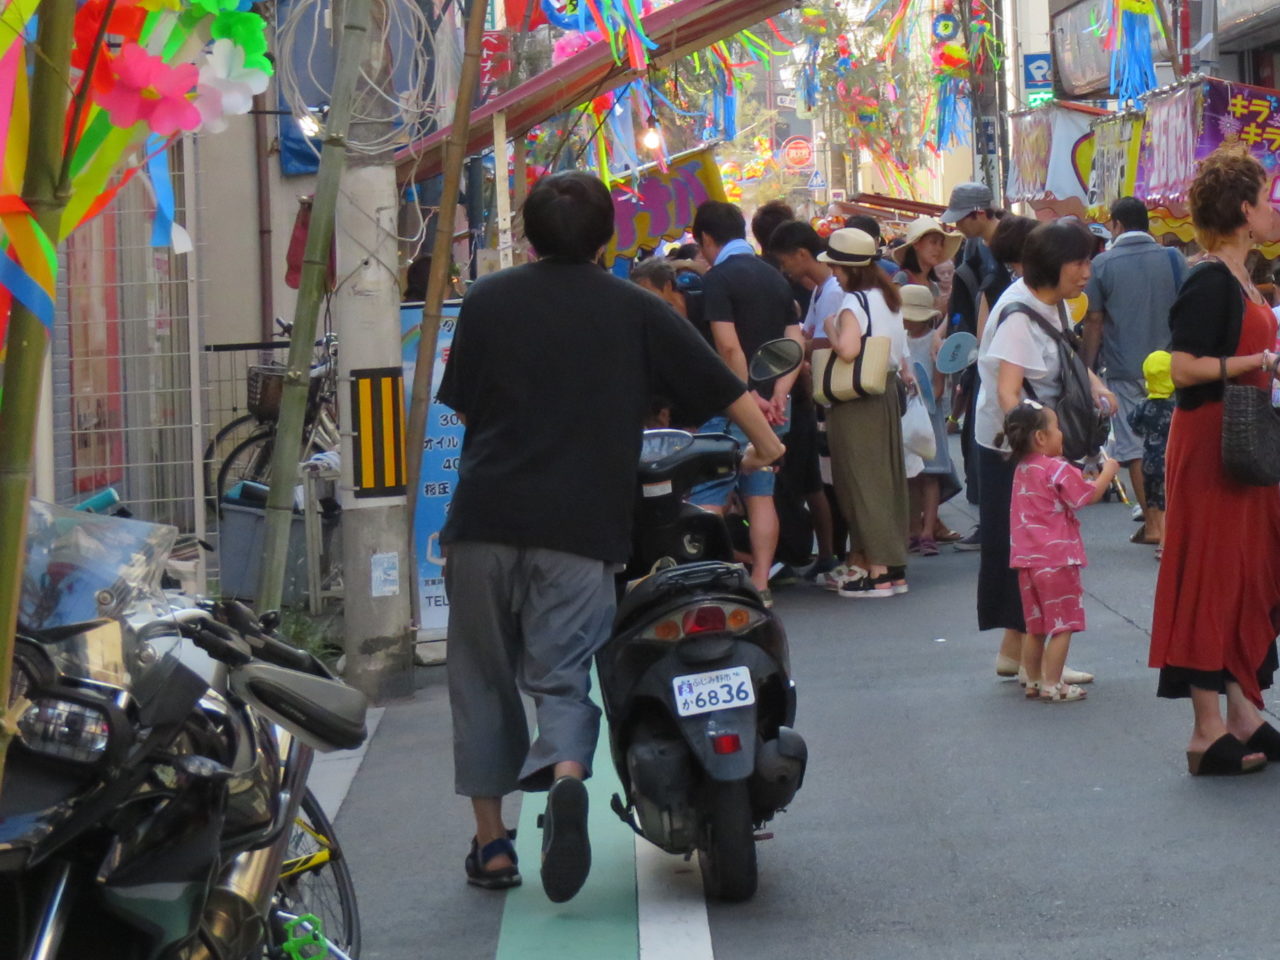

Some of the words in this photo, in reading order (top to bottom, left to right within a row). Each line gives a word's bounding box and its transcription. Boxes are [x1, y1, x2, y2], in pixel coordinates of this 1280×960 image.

[1230, 94, 1271, 123] キラ
[423, 436, 459, 450] オイル
[425, 596, 450, 607] TEL
[695, 681, 749, 708] 6836
